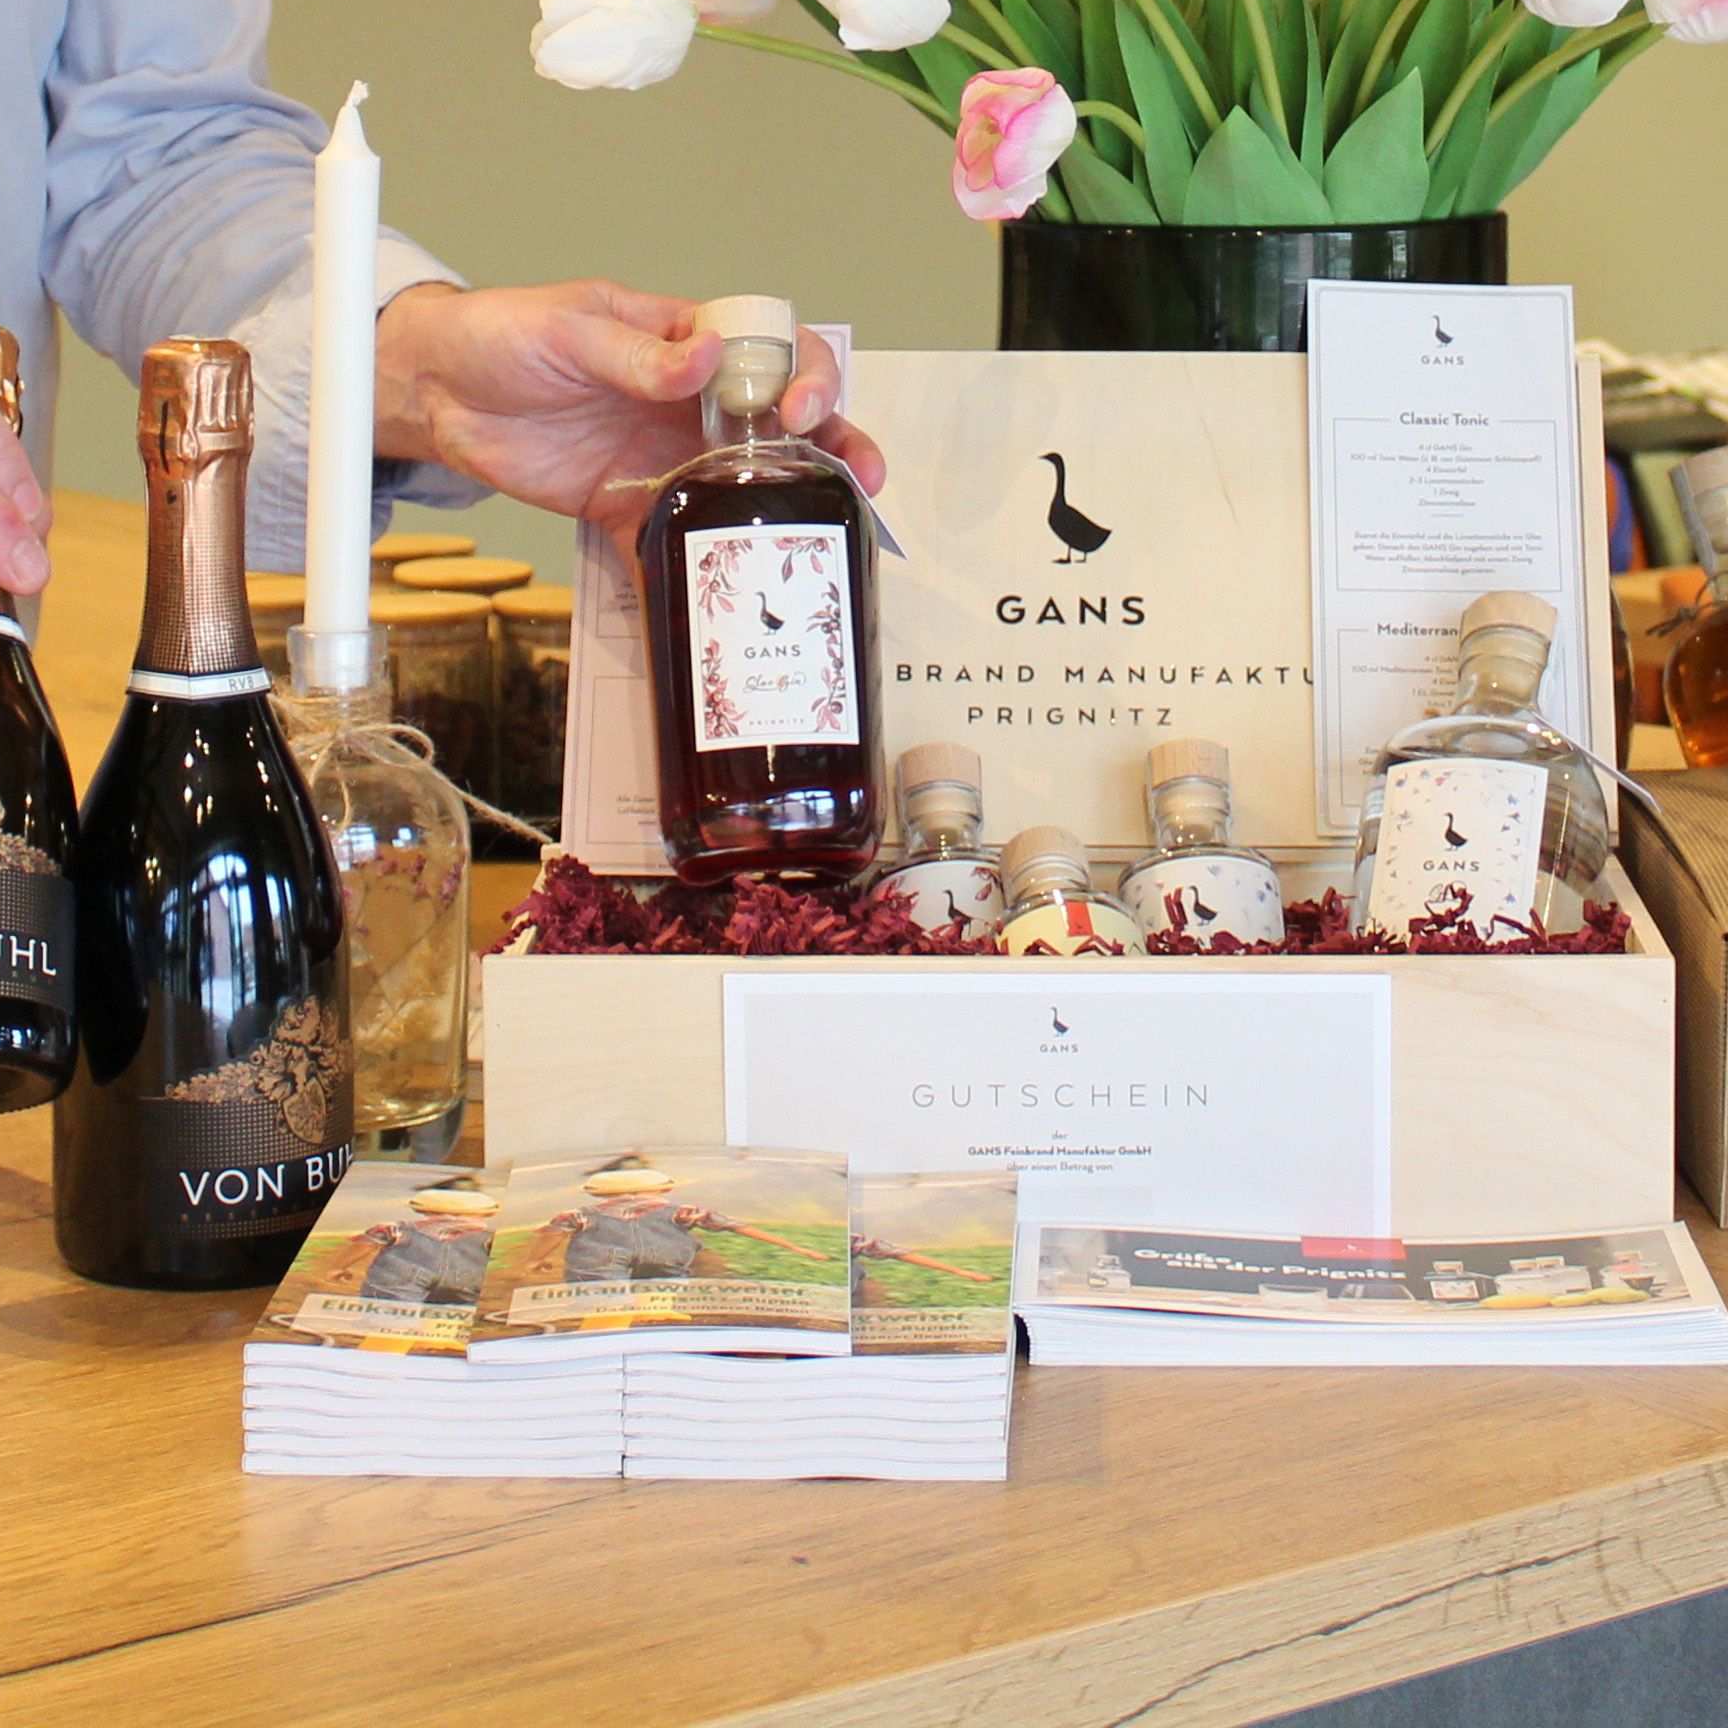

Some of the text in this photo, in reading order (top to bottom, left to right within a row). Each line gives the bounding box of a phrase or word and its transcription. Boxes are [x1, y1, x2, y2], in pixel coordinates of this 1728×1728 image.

[1420, 354, 1465, 366] GANS
[1399, 412, 1489, 427] Classic Tonic
[995, 595, 1146, 626] GANS
[1377, 621, 1460, 637] Mediterran
[744, 644, 802, 660] GANS
[1064, 665, 1314, 686] MANUFAKTU
[966, 705, 1173, 727] PRIGNITZ
[1423, 859, 1481, 872] GANS
[1039, 1044, 1079, 1054] GANS
[911, 1083, 1209, 1109] GUTSCHEIN
[967, 1145, 1152, 1156] GANS Feinbrand Manufaktur GmbH
[179, 1163, 286, 1206] VON
[322, 1298, 473, 1321] Einkaufsw
